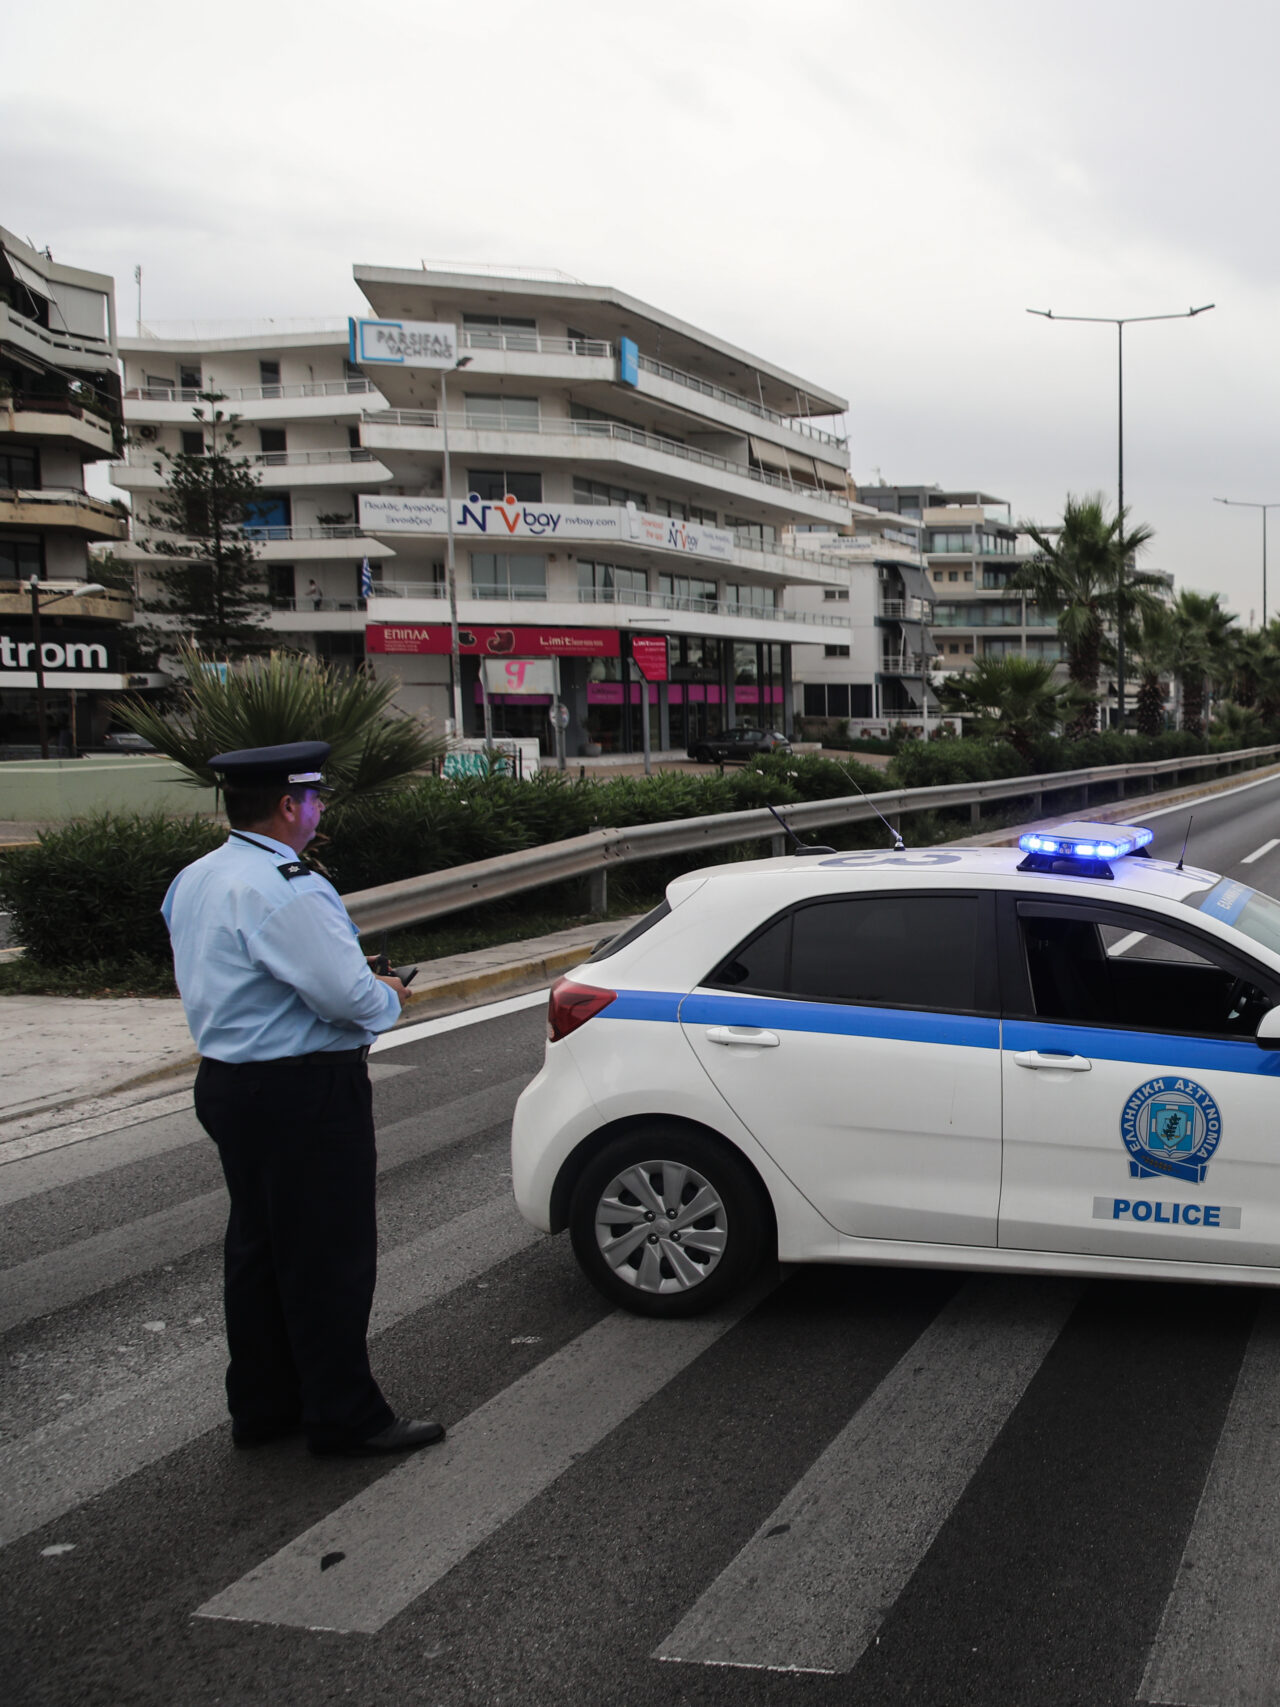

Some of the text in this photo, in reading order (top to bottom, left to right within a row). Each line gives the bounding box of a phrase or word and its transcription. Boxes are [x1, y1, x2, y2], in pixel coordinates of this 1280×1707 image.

[376, 330, 452, 347] PARSIFAL
[387, 343, 453, 359] YACHTING
[565, 514, 617, 527] nvbay.com
[384, 628, 430, 641] ΕΠΙΠΛΑ
[1124, 1079, 1220, 1159] ΕΛΛΗΝΙΚΗ ΑΣΤΥΝΟΜΙΑ
[1113, 1199, 1221, 1227] POLICE
